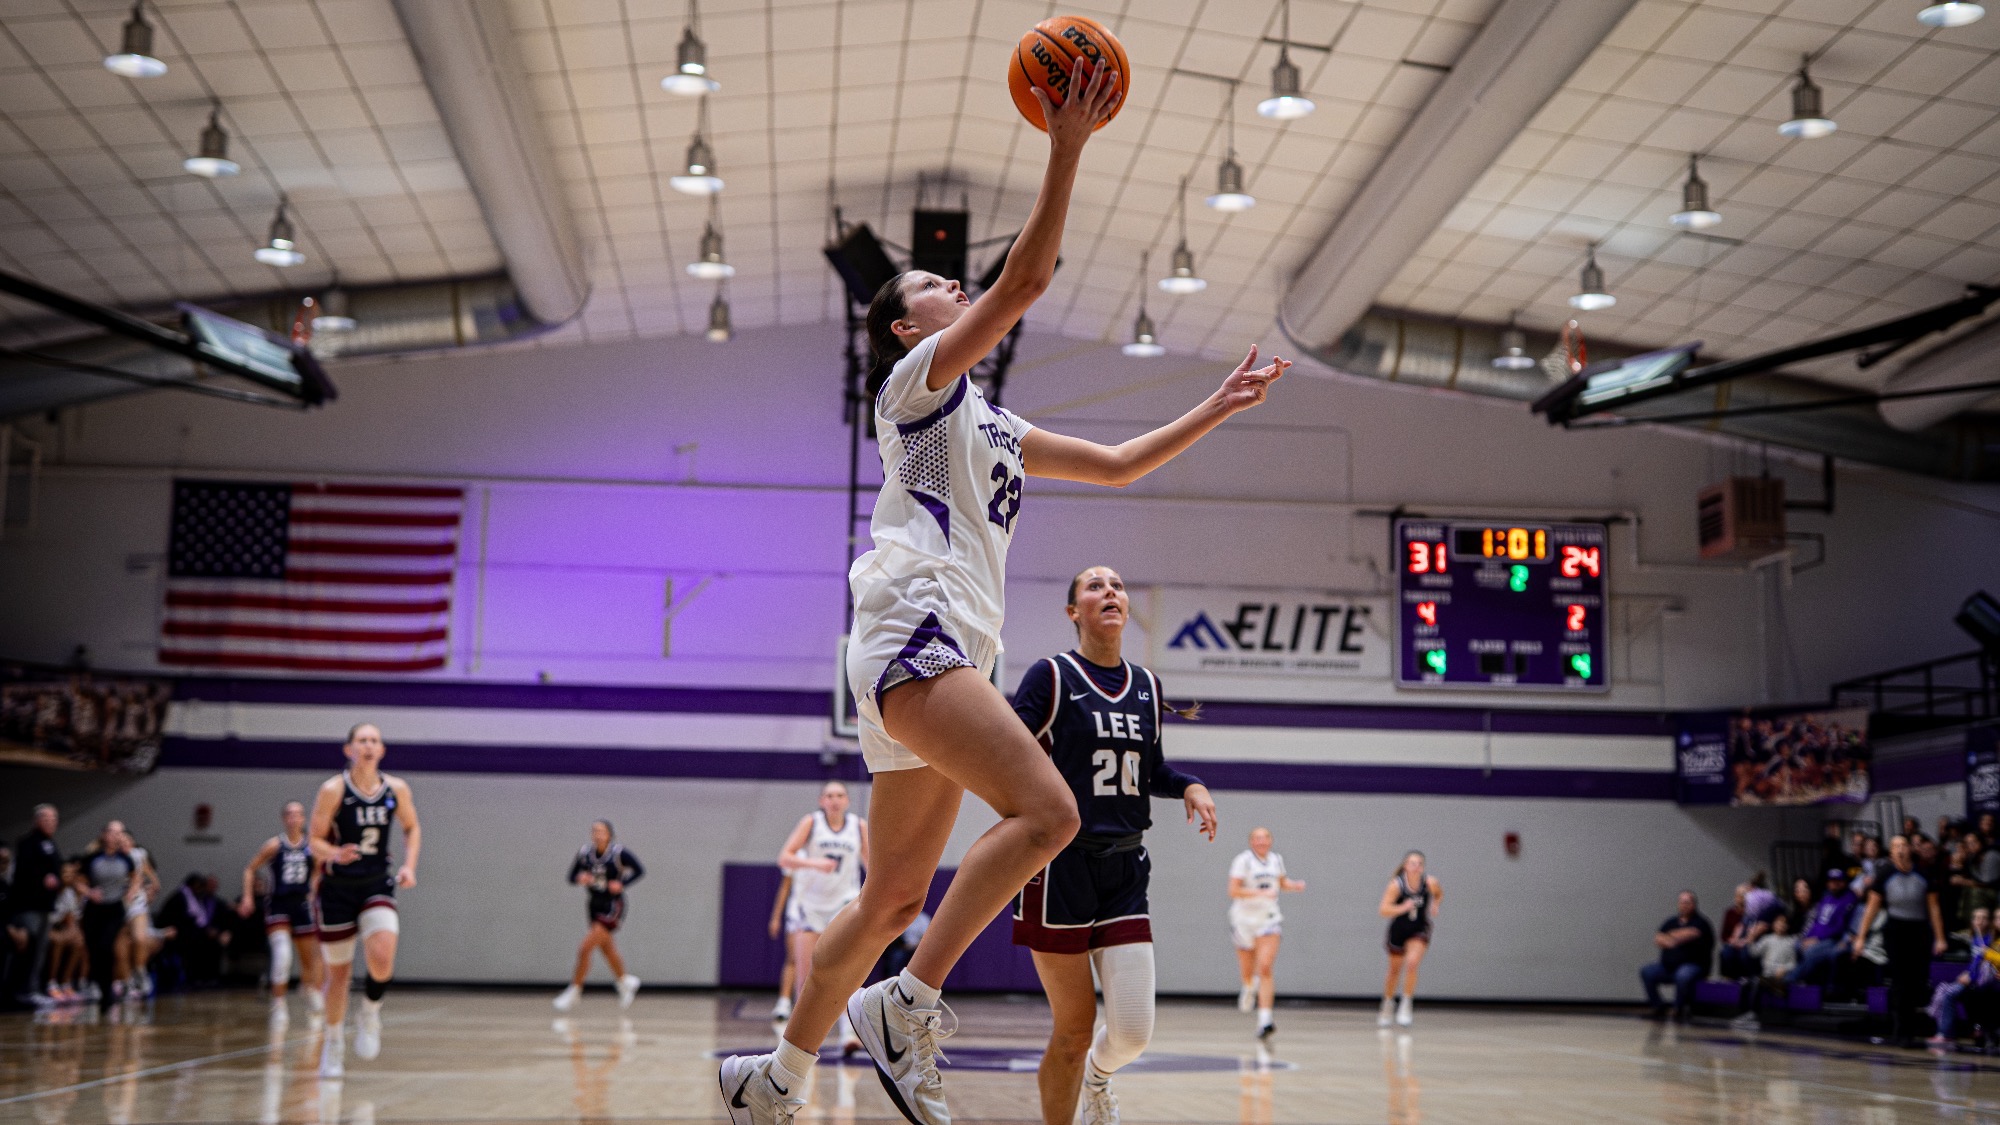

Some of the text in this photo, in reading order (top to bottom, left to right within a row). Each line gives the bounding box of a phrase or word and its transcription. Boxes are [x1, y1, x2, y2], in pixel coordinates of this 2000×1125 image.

[1031, 39, 1085, 101] ilson
[1407, 541, 1447, 574] 31
[1482, 527, 1546, 560] 1:01
[1561, 545, 1600, 578] 24
[1510, 564, 1529, 592] 2
[1416, 600, 1436, 626] 4
[1567, 604, 1586, 631] 2
[1223, 603, 1371, 654] ELITE
[1426, 649, 1447, 675] 4
[1571, 653, 1591, 679] 4
[1138, 690, 1150, 700] LC
[1092, 711, 1144, 741] LEE
[1092, 749, 1142, 797] 20
[356, 805, 389, 826] LEE
[360, 827, 381, 855] 2
